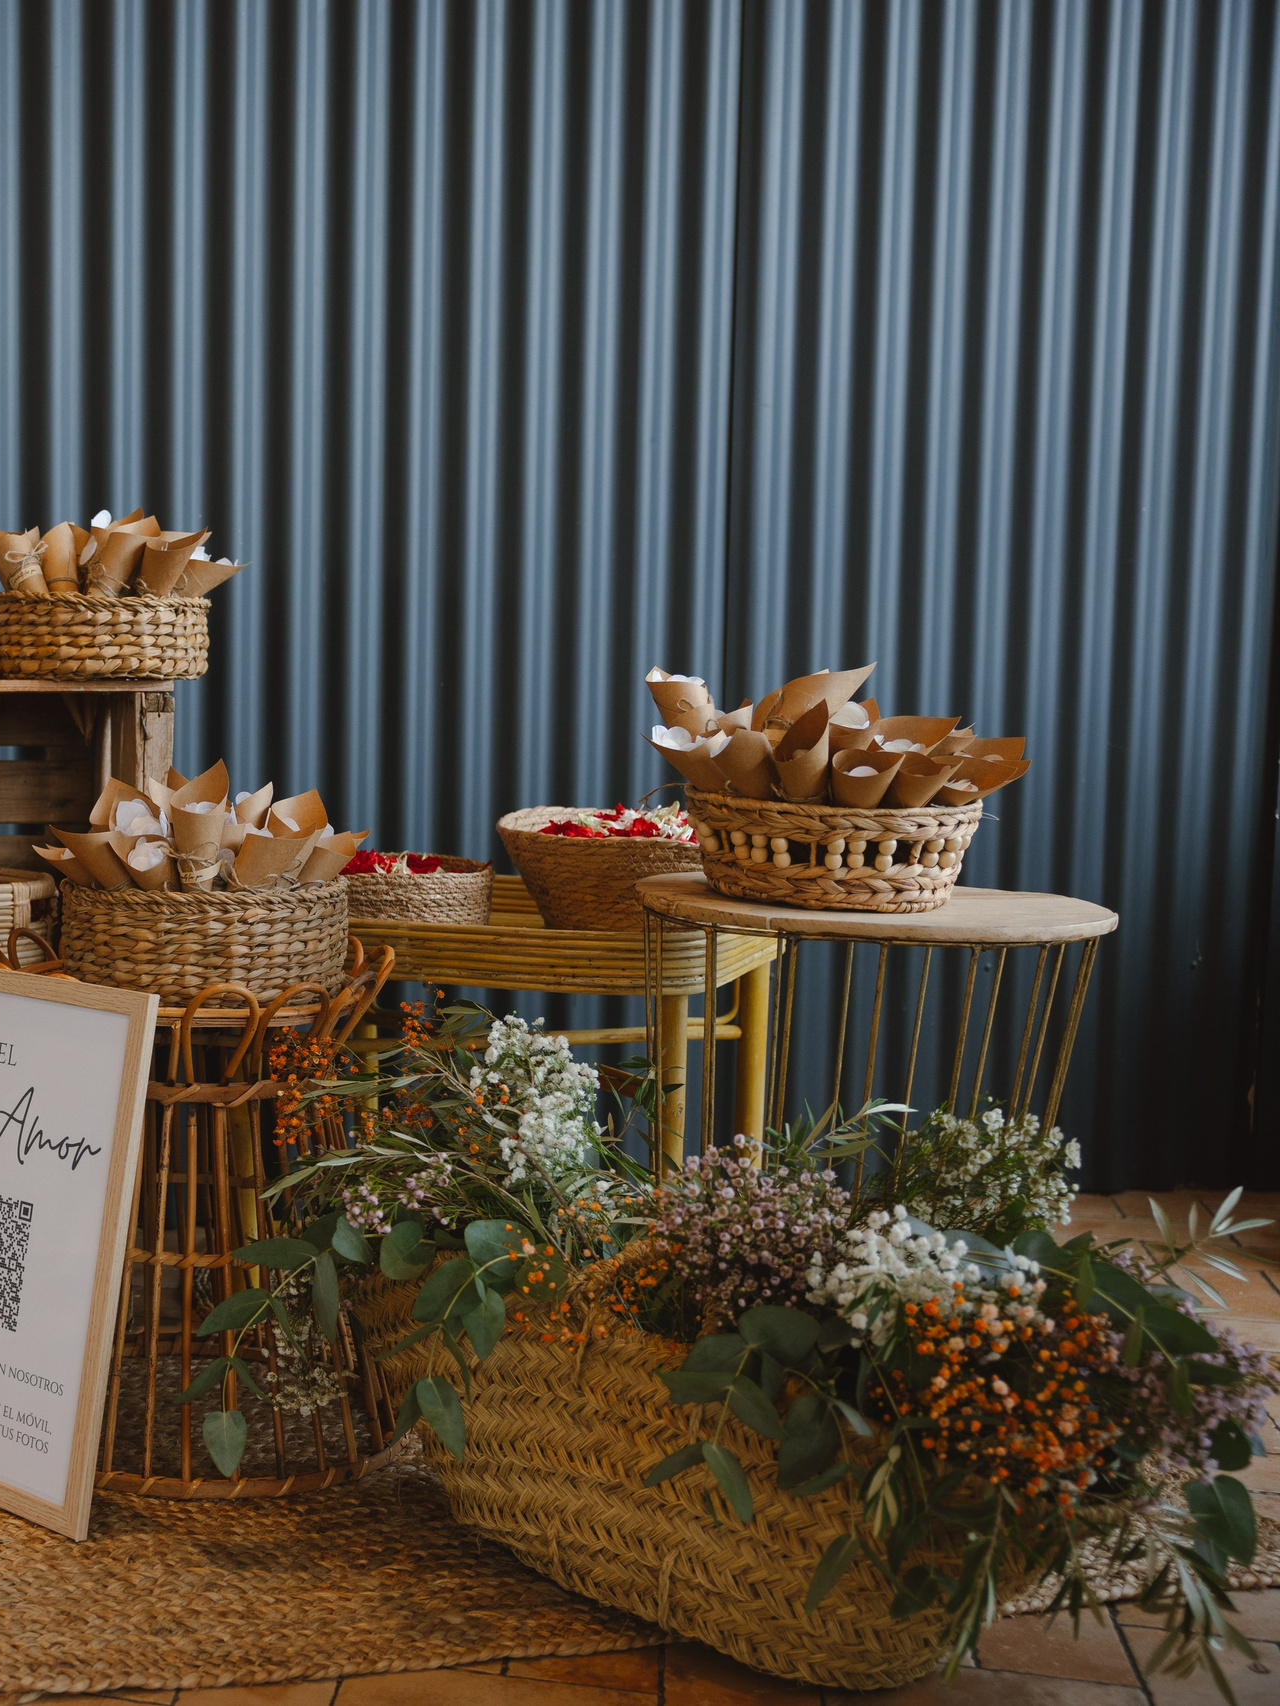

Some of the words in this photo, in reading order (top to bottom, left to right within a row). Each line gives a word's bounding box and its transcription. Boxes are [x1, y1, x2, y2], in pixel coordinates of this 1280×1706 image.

[8, 1367, 64, 1396] NOSOTROS
[3, 1406, 14, 1419] EL
[16, 1411, 52, 1435] MÓVIL,
[16, 1431, 49, 1453] FOTOS
